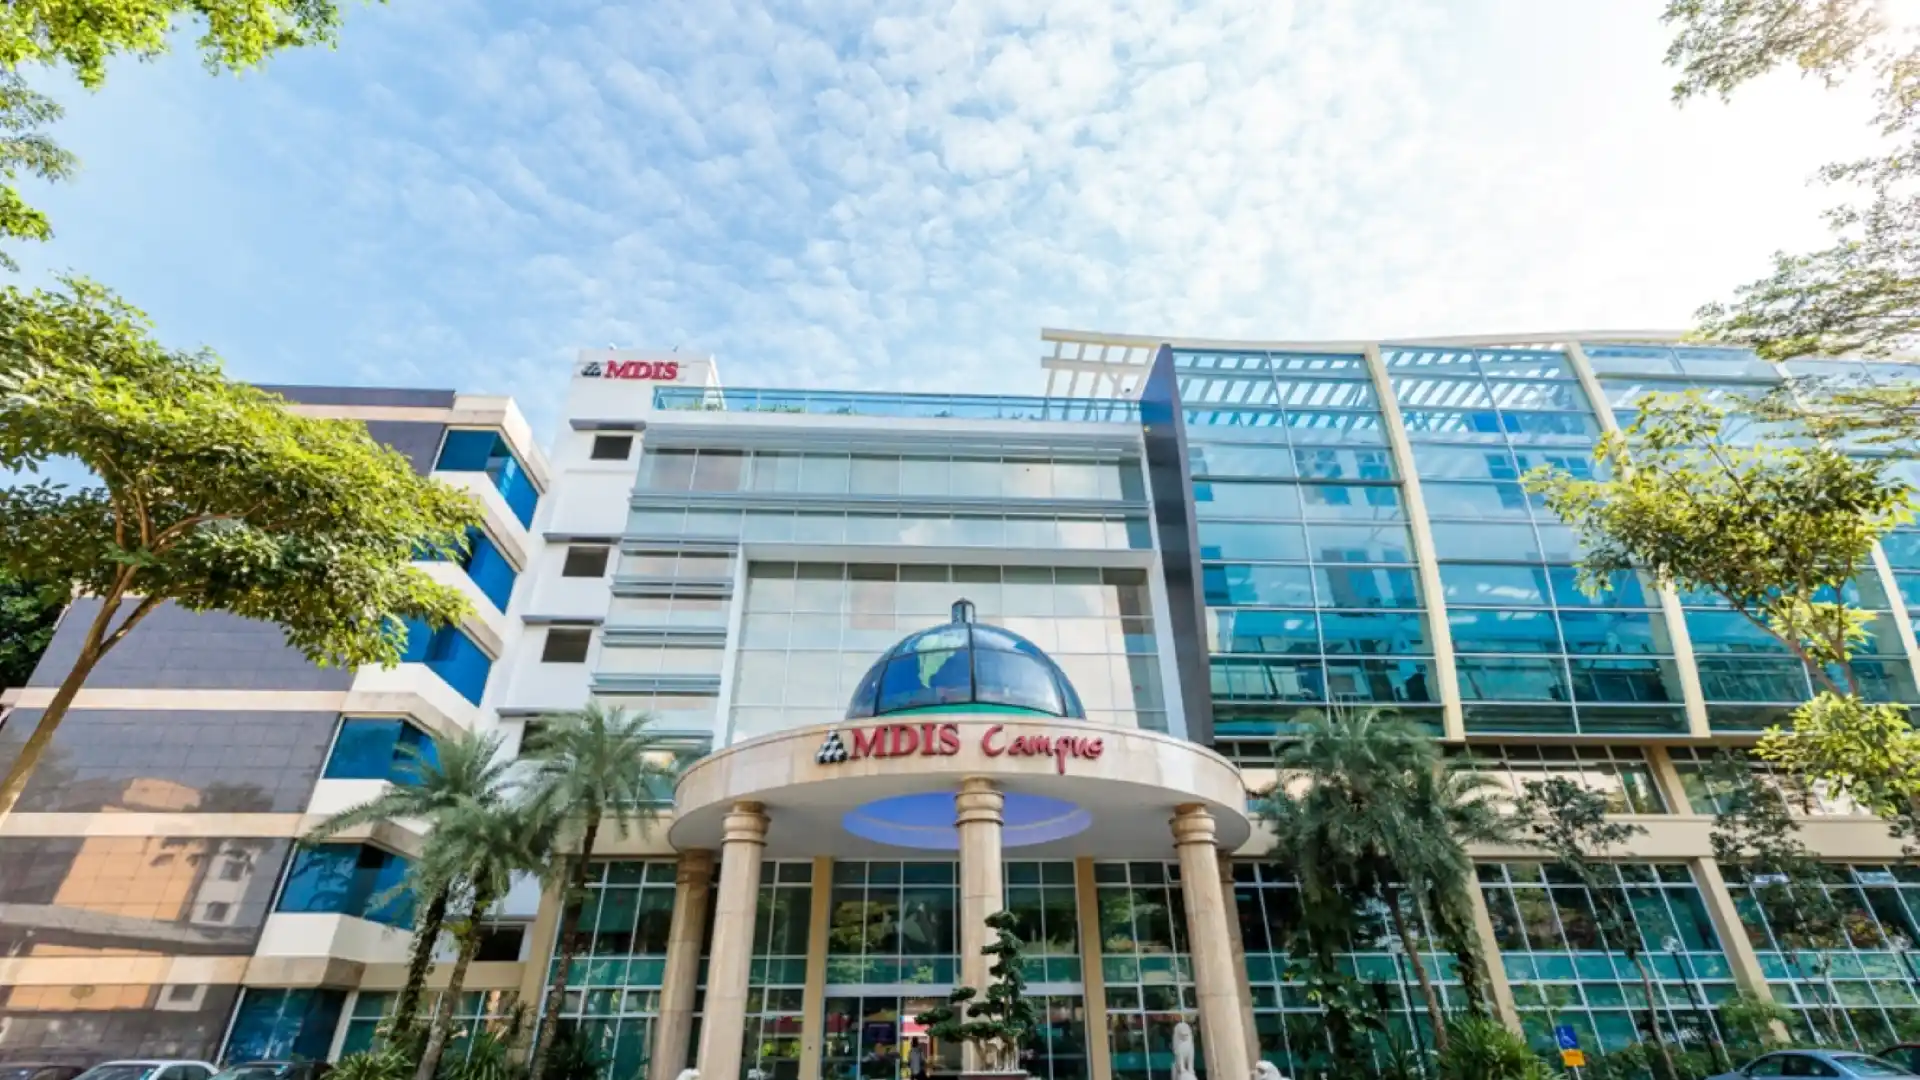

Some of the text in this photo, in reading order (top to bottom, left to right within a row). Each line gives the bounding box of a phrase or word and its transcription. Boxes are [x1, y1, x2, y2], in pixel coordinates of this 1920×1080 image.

[605, 361, 678, 380] MDIS
[850, 723, 1104, 775] MDIS Campus
